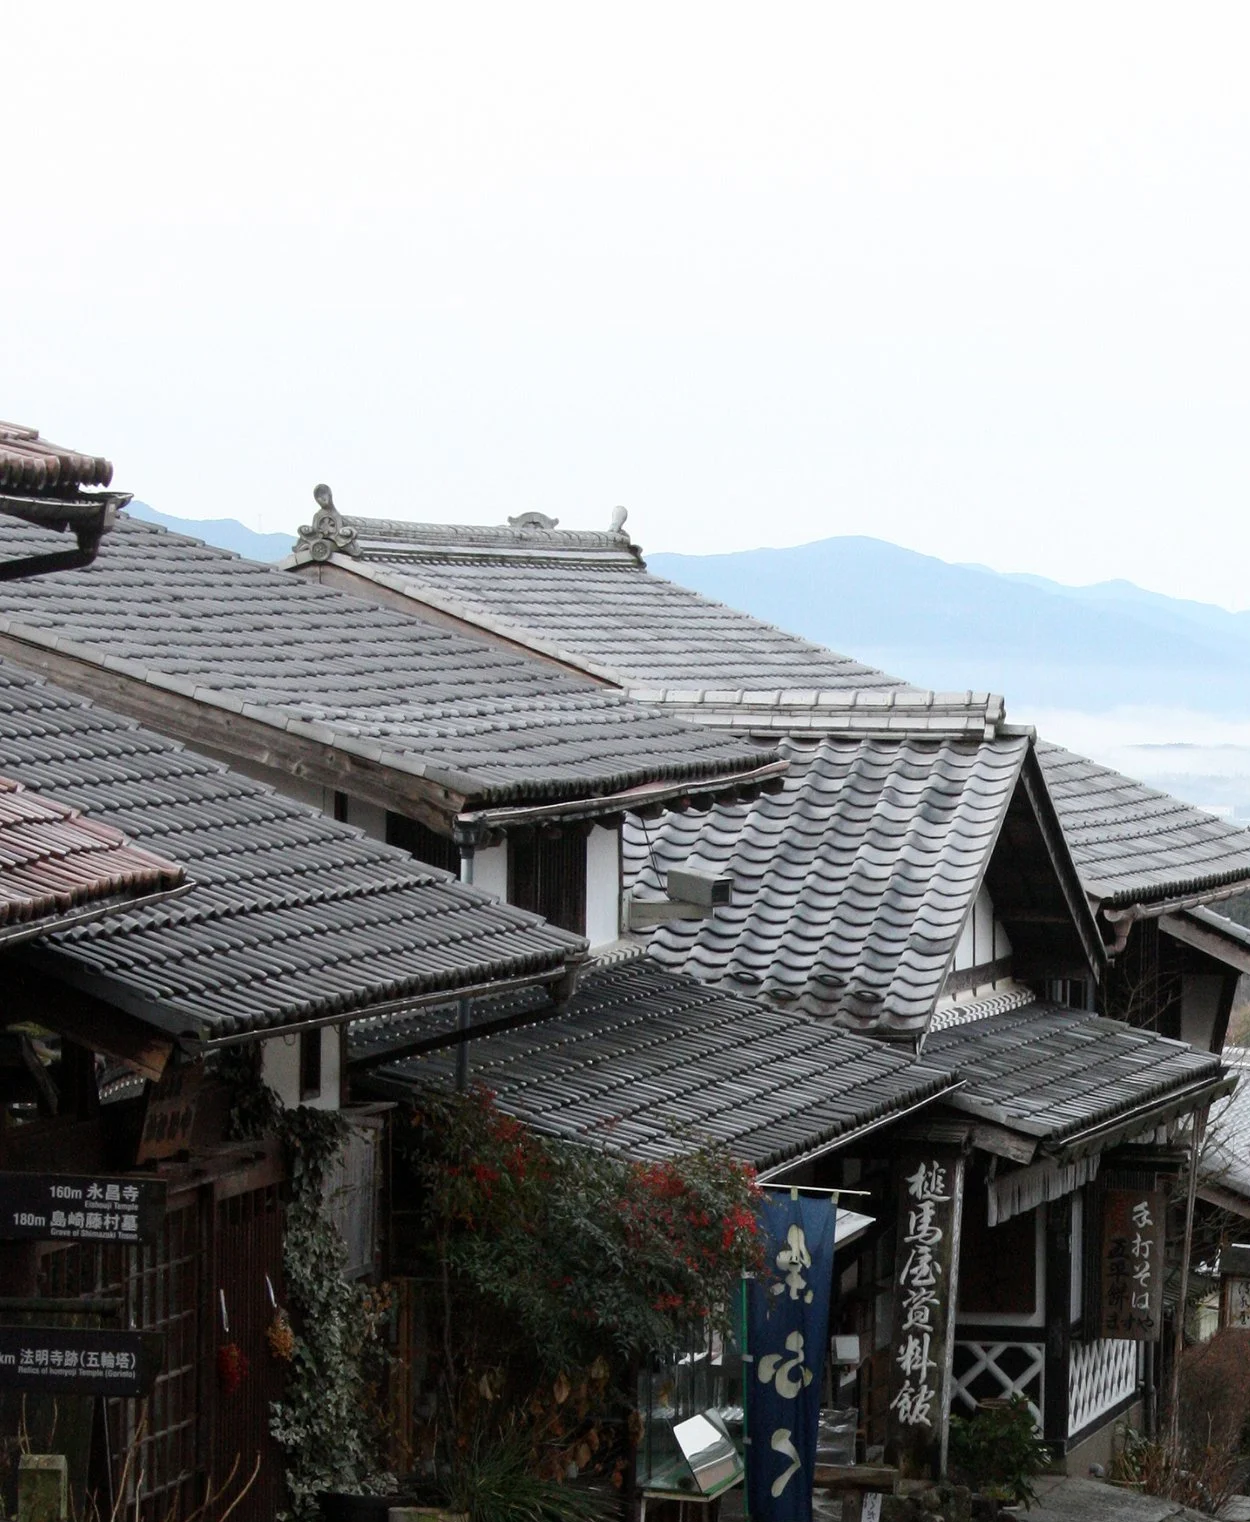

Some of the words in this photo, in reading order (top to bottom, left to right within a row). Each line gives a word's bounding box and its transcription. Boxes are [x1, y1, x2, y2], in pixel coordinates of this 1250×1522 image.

[49, 1185, 83, 1200] 160m
[86, 1183, 140, 1202] 永昌寺
[114, 1203, 139, 1211] Temple
[12, 1213, 46, 1227] 180m
[50, 1210, 139, 1231] 島崎藤村墓
[50, 1227, 71, 1237] Grave
[72, 1229, 80, 1237] of
[41, 1366, 48, 1375] of
[79, 1368, 104, 1377] Temple
